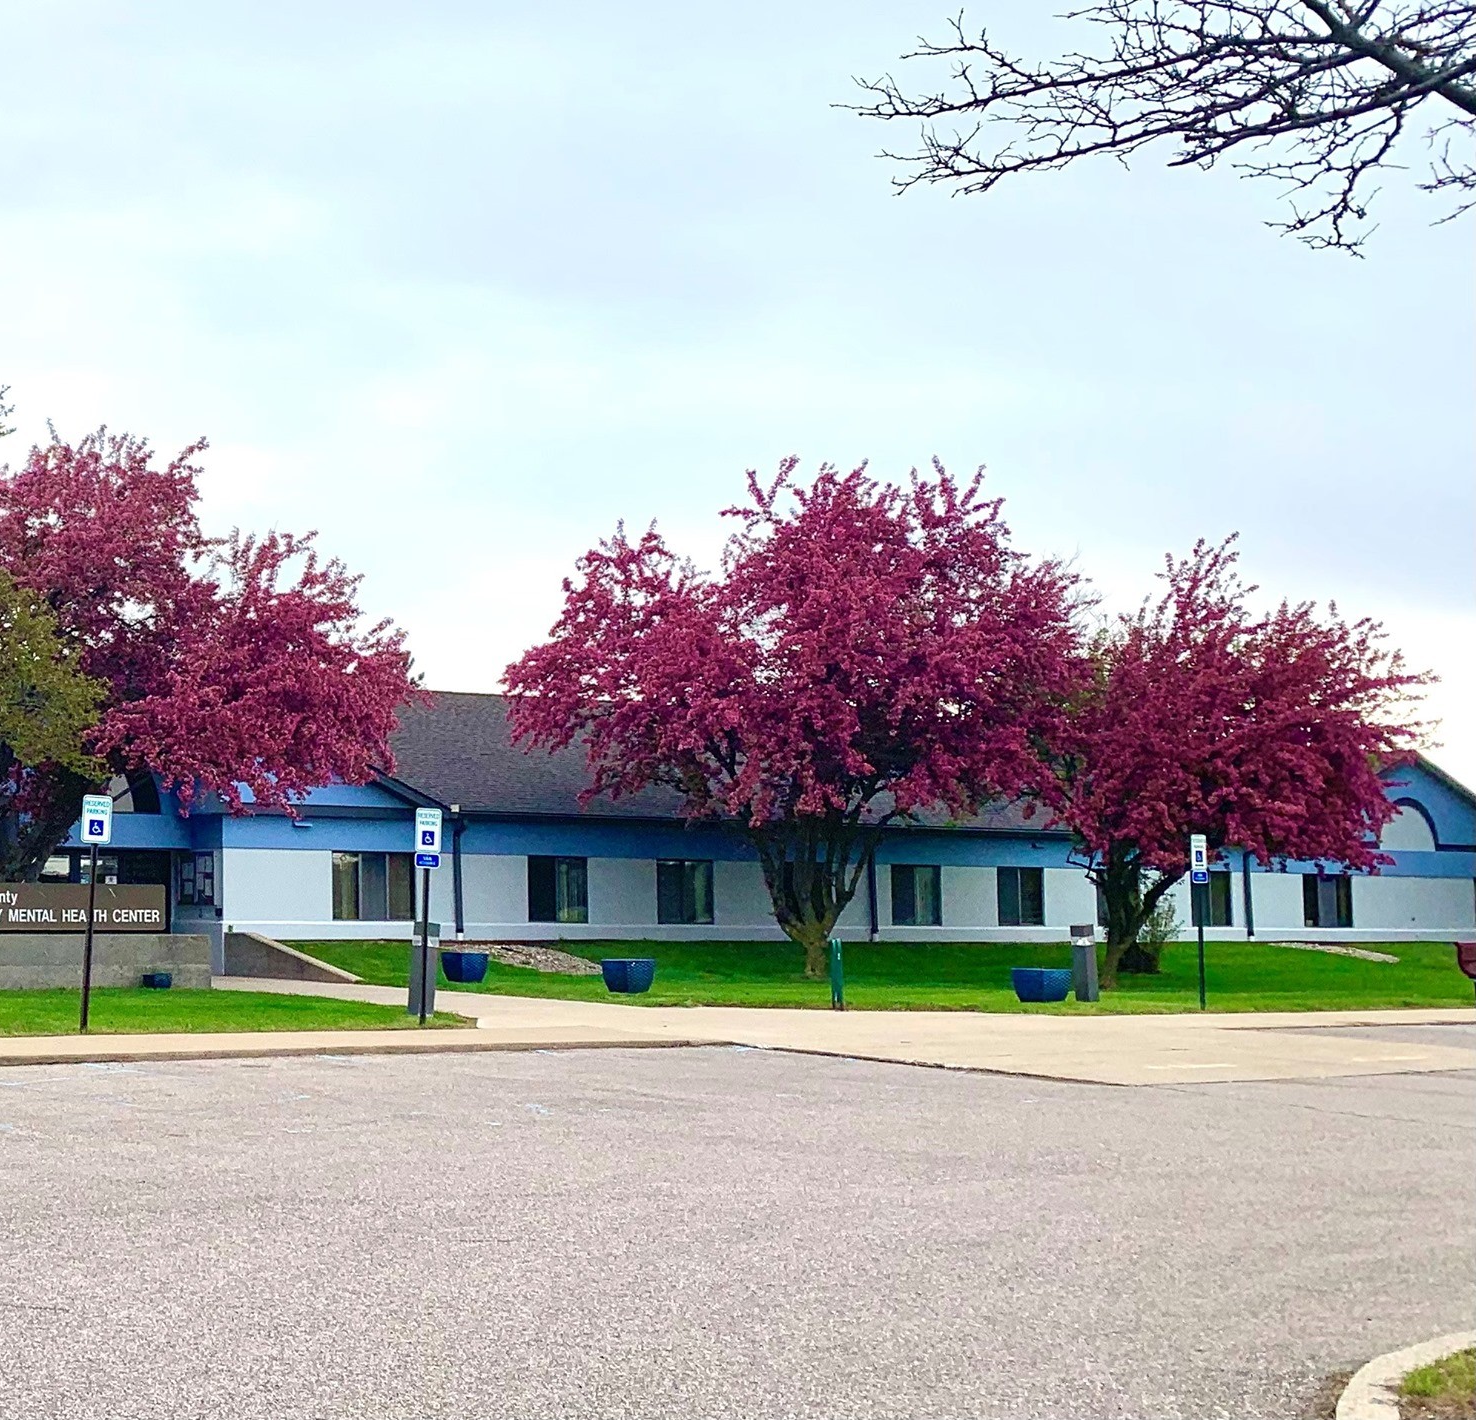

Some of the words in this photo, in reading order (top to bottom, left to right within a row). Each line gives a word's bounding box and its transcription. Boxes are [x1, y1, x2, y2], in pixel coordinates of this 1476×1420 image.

[8, 909, 57, 922] MENTAL
[62, 909, 108, 922] HEATH
[112, 909, 160, 923] CENTER
